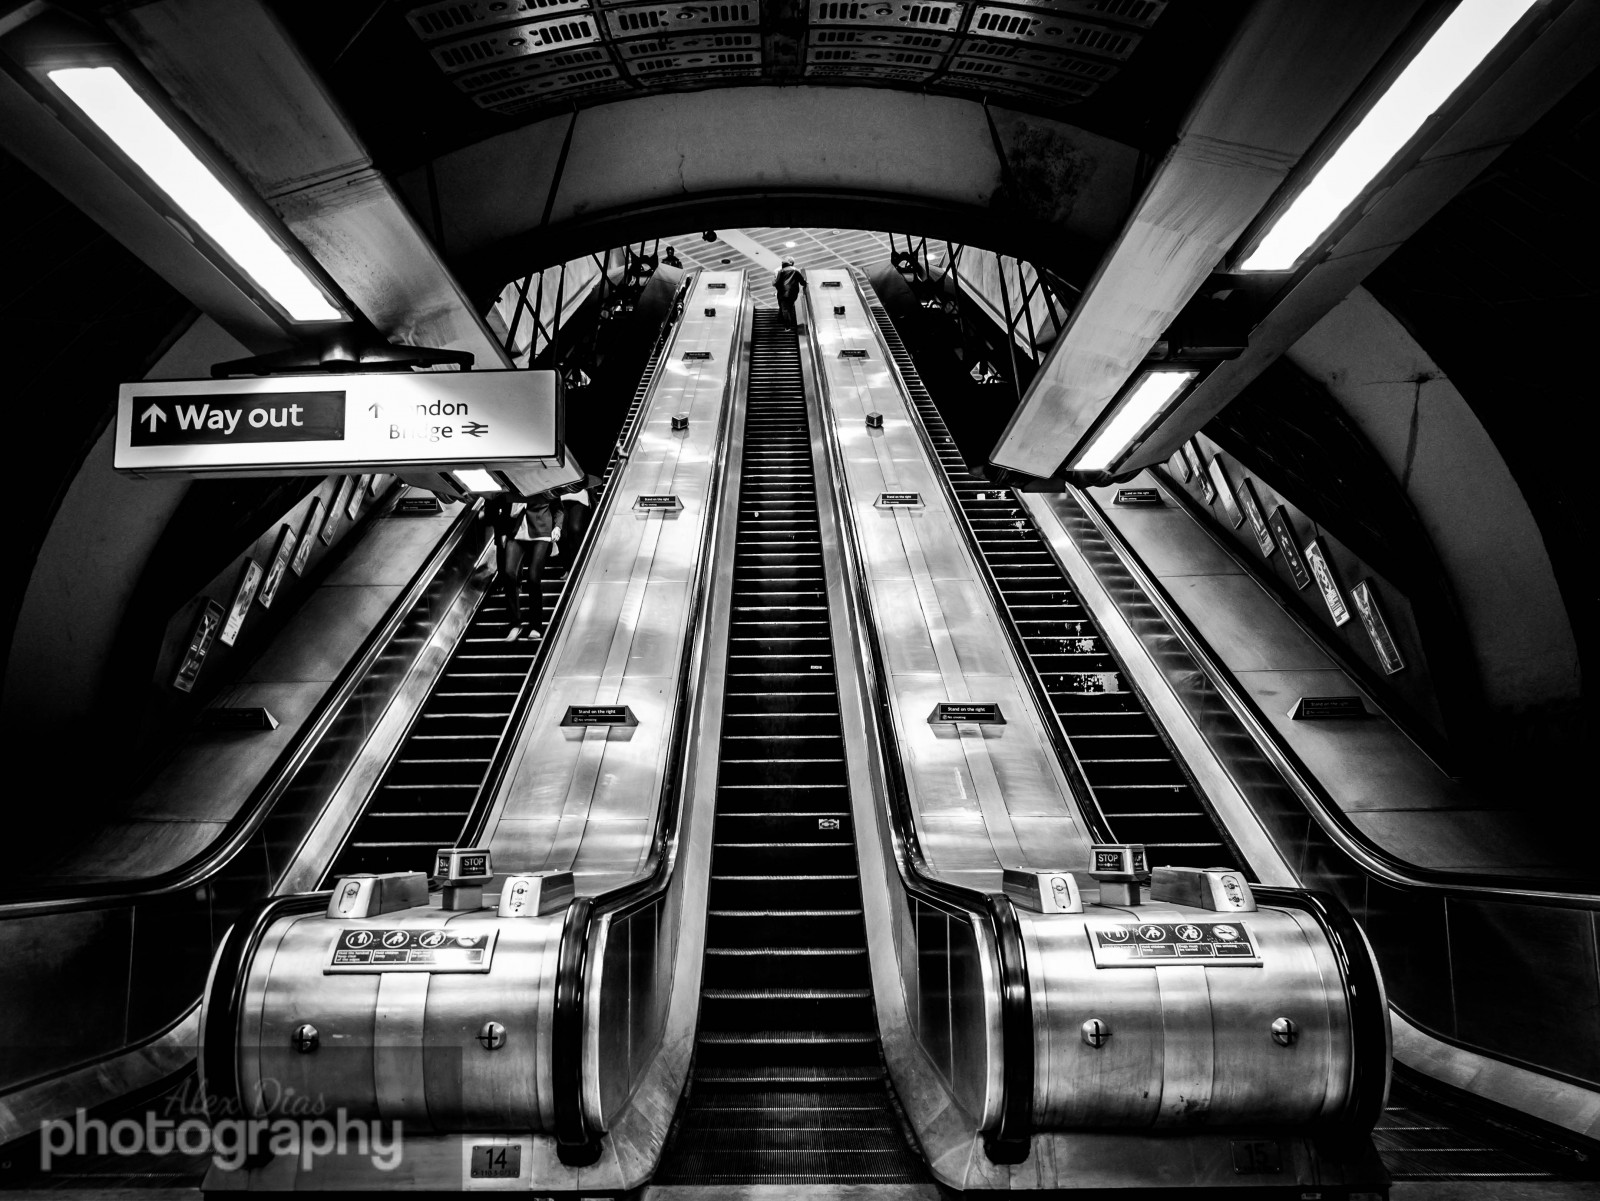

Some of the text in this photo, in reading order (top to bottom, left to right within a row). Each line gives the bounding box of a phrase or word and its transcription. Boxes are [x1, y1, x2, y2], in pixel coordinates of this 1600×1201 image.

[408, 399, 469, 416] ndon
[174, 403, 304, 435] Way out
[464, 857, 484, 866] STOP
[1098, 853, 1118, 862] STOP
[486, 1147, 507, 1169] 14
